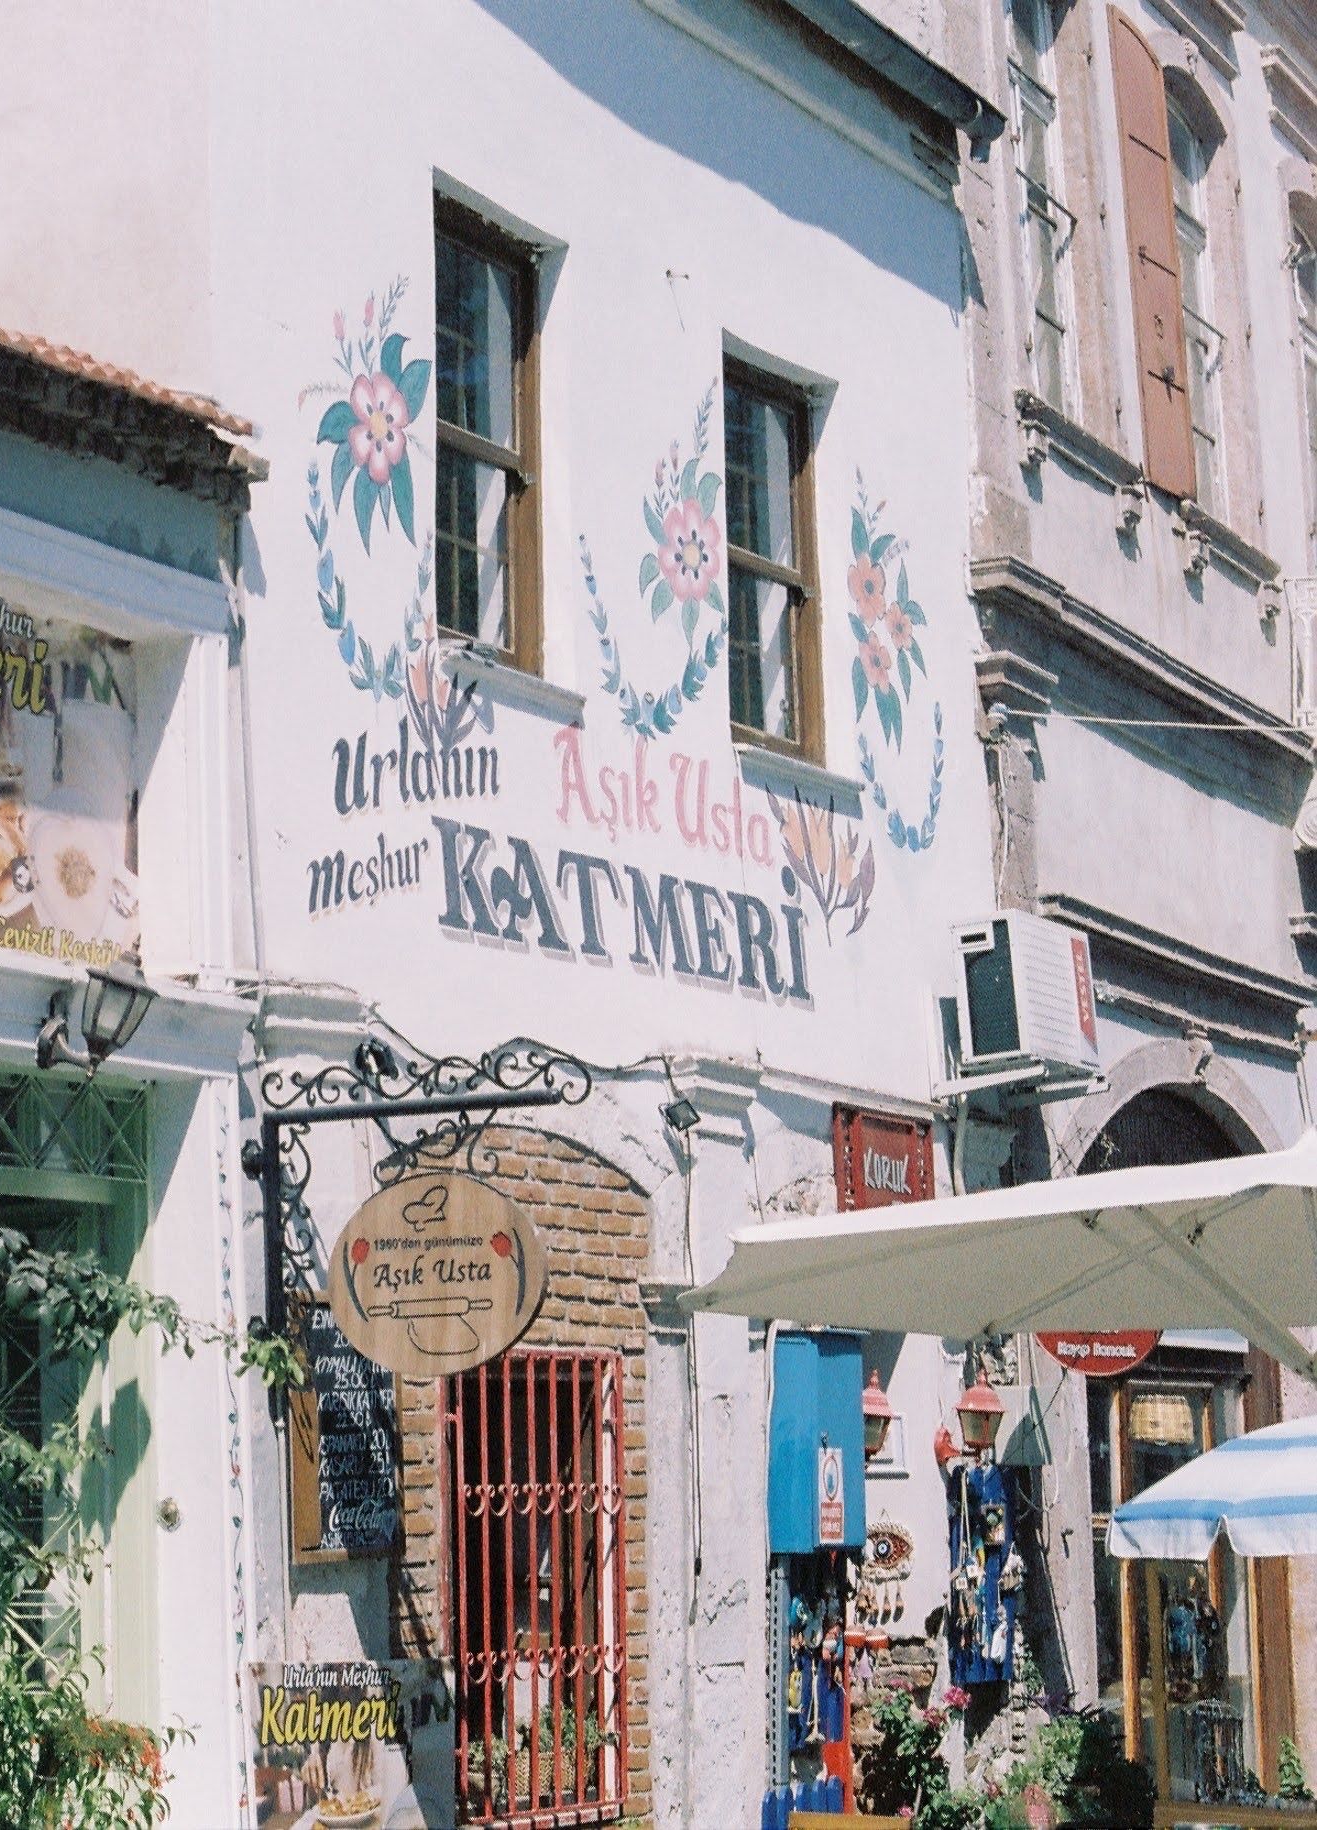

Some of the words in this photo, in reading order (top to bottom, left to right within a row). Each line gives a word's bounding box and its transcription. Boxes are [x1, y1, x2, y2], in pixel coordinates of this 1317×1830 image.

[553, 726, 662, 843] Aşık
[669, 752, 775, 869] Usta
[306, 832, 429, 915] Meşhur
[431, 815, 813, 1005] KATMERİ
[373, 1254, 424, 1294] Aşık
[433, 1258, 492, 1283] Usta
[284, 1664, 338, 1689] Urla'nın
[341, 1664, 390, 1689] Meşhur
[260, 1681, 401, 1746] Katmeri
